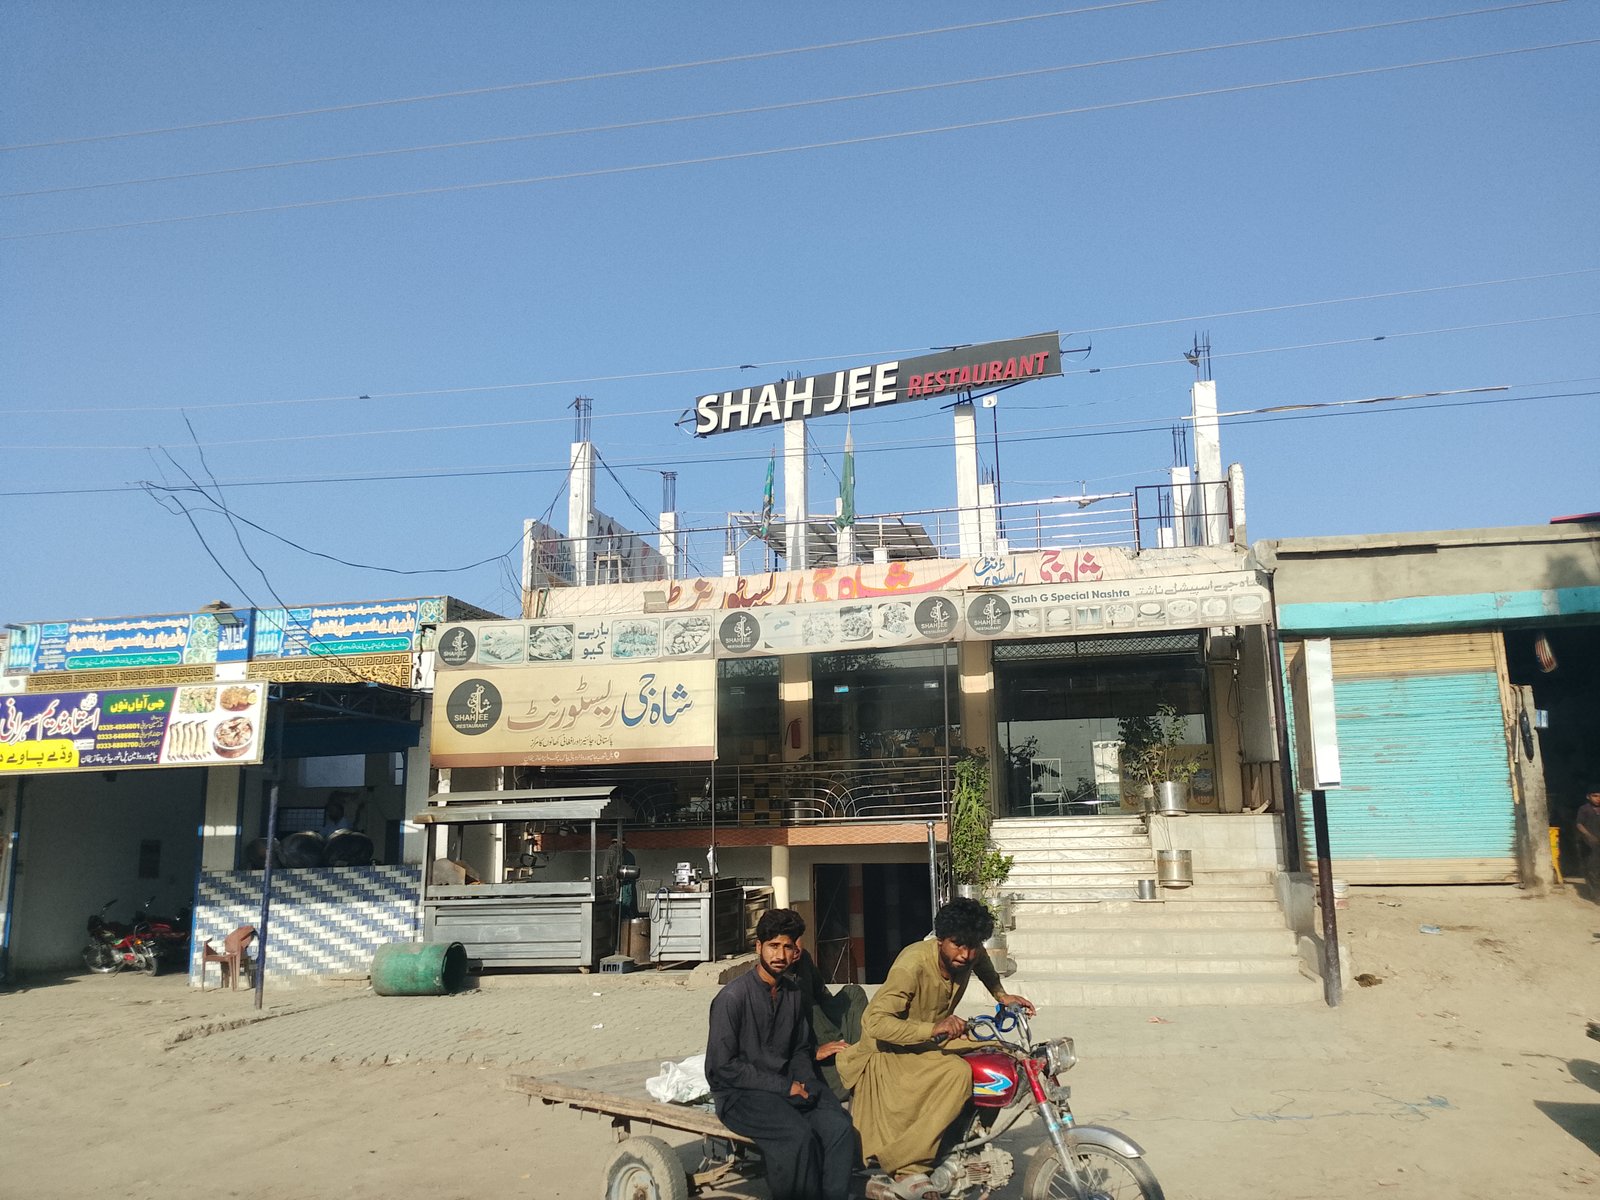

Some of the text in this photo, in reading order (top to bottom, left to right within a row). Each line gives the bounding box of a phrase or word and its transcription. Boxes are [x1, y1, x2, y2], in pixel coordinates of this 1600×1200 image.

[696, 351, 1050, 434] SHAH JEE RESTAURANT
[1011, 589, 1130, 605] Shah G Special Nashta
[581, 641, 606, 659] کیو
[507, 673, 693, 730] شاہ جی ریسٹورنٹ
[454, 714, 475, 722] SHAH
[6, 750, 44, 767] پاوے
[46, 745, 72, 763] وڈے
